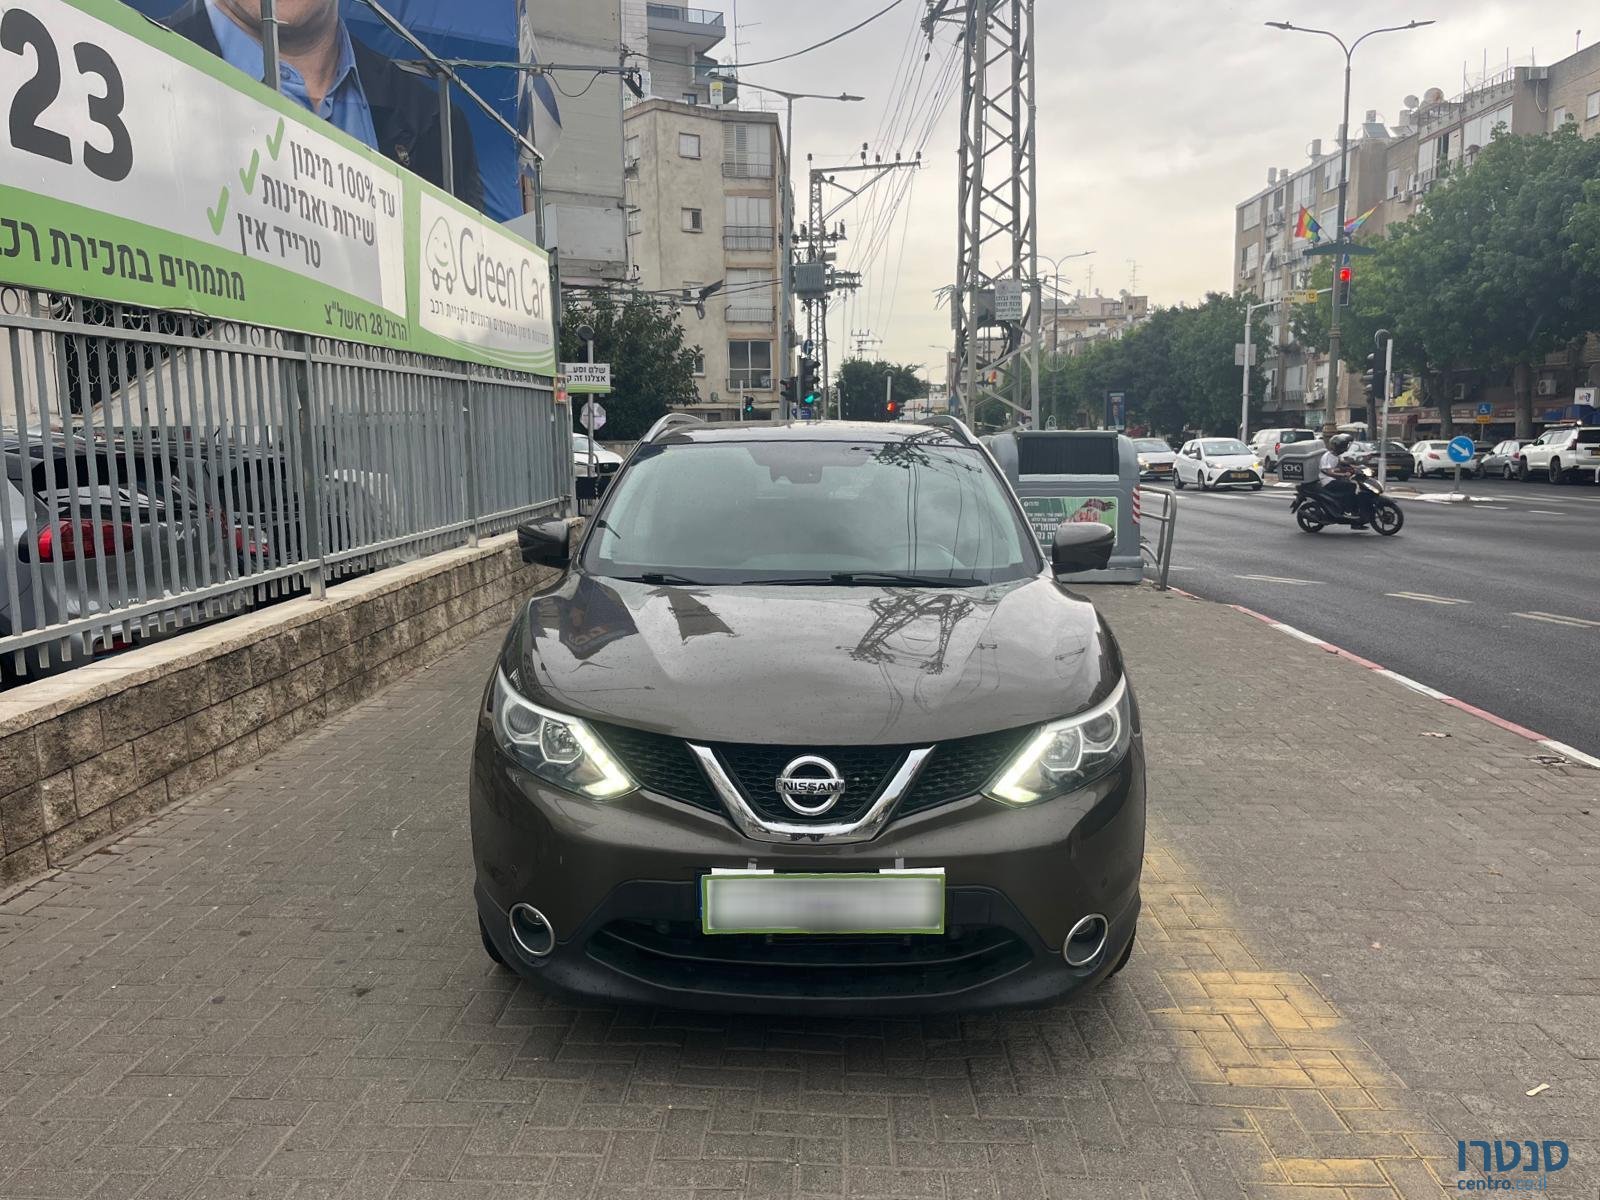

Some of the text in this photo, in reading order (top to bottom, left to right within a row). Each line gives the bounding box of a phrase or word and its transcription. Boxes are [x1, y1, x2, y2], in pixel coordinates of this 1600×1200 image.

[1, 8, 133, 182] 23
[290, 141, 395, 218] עד 100% מימון
[261, 173, 375, 246] שירות ואמינות
[237, 212, 321, 268] טרייד אין
[0, 217, 246, 301] מתמחים במכירת רכ
[459, 227, 545, 320] Green Car
[430, 298, 444, 316] רכב
[369, 312, 383, 336] 28
[384, 314, 407, 341] הרצל
[574, 374, 583, 382] זה
[584, 374, 606, 382] אצלנו
[588, 365, 606, 374] שלם
[783, 781, 839, 791] NISSAN
